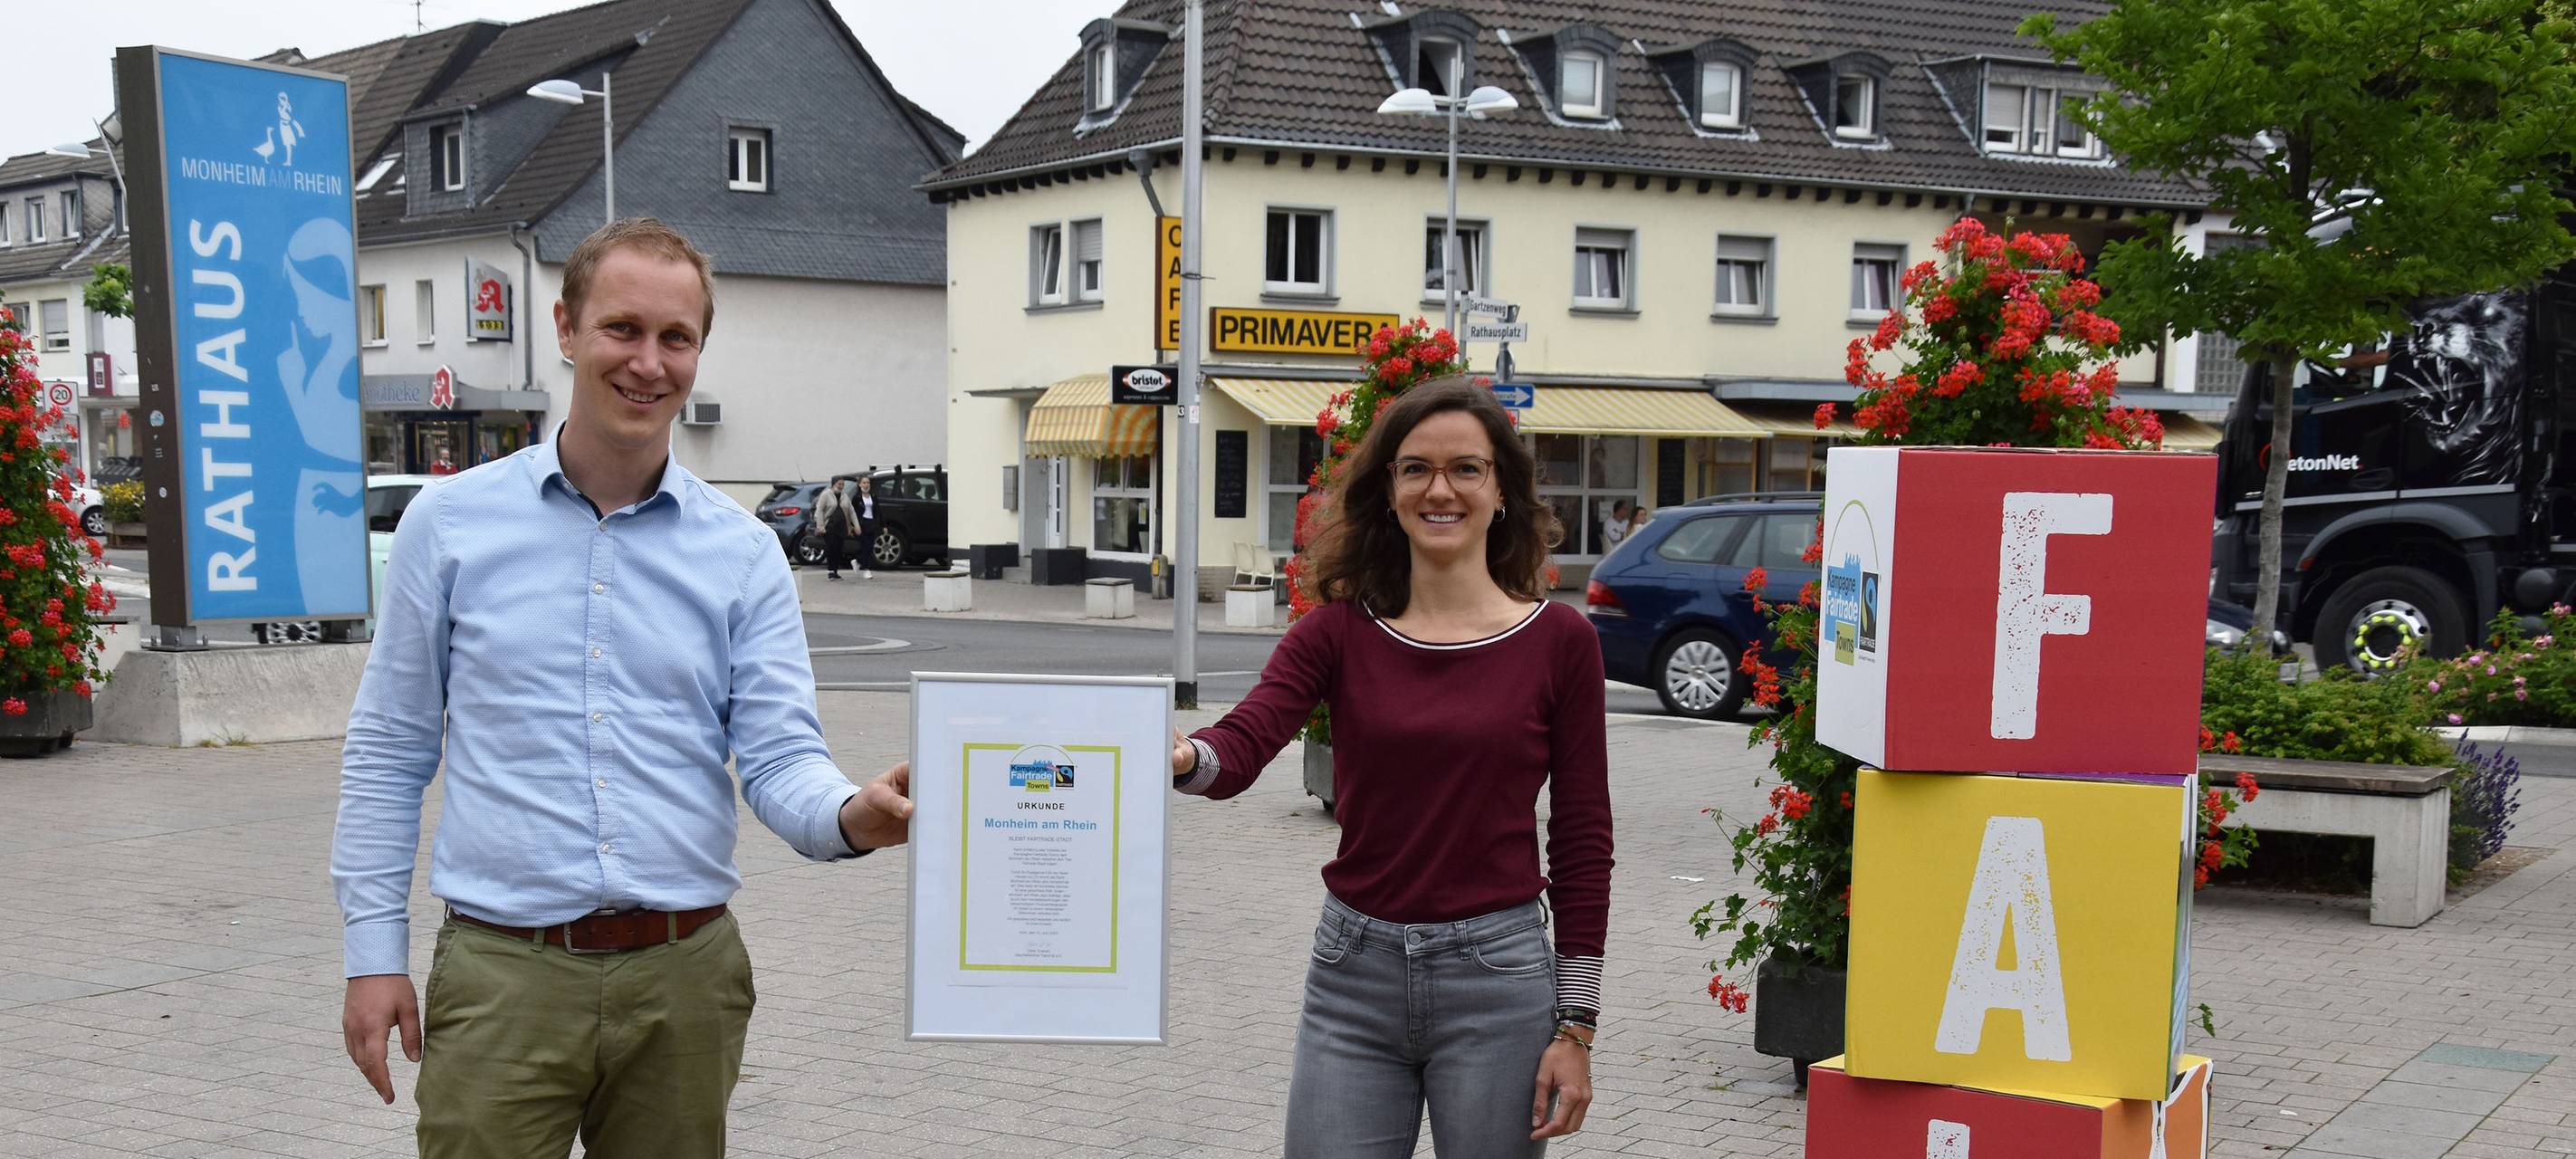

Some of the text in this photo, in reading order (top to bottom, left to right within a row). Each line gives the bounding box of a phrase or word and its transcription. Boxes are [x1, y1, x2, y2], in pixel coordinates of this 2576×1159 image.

[181, 158, 342, 196] MONHEIM AM RHEIN
[1470, 300, 1507, 317] Gartzenweg
[1220, 315, 1389, 348] PRIMAVER
[1470, 326, 1521, 340] Rathausplatz
[54, 389, 68, 400] 20
[189, 219, 258, 593] RATHAUS
[1827, 569, 1856, 595] Kampagne
[1825, 590, 1859, 622] Fairtrade
[1990, 491, 2113, 741] F
[1836, 630, 1854, 654] Towns
[1010, 771, 1052, 780] Fairtrade
[1017, 802, 1065, 810] URKUNDE
[984, 819, 1038, 829] Monheim
[1063, 820, 1096, 830] Rhein
[1934, 816, 2072, 1062] A
